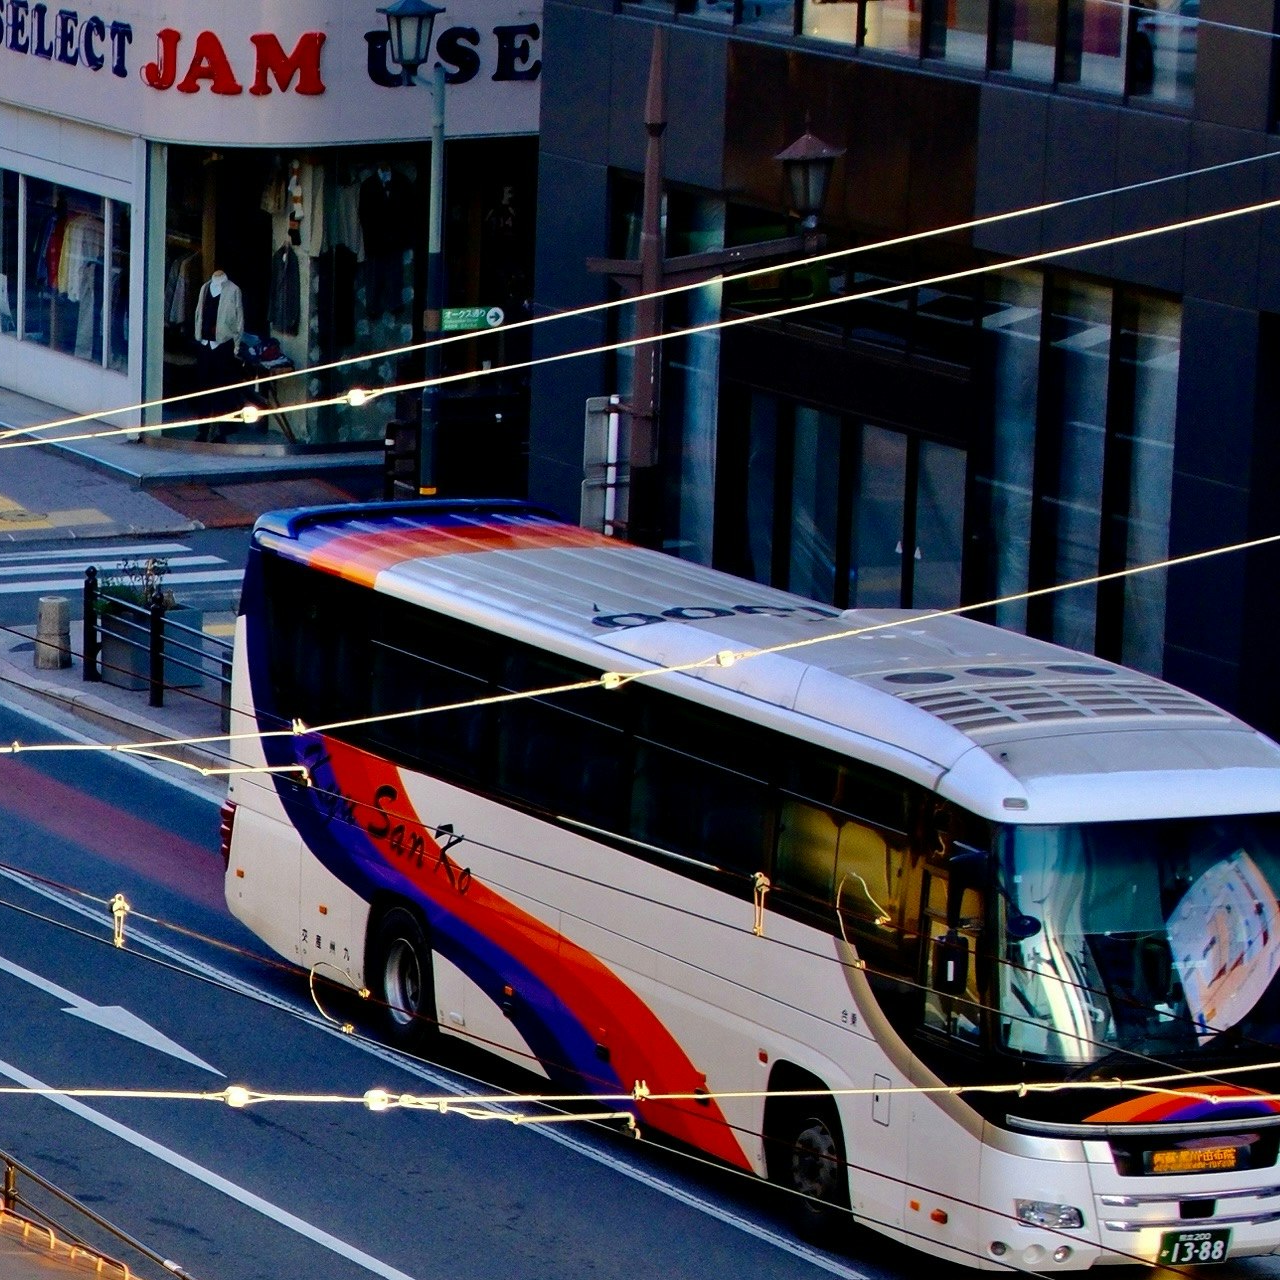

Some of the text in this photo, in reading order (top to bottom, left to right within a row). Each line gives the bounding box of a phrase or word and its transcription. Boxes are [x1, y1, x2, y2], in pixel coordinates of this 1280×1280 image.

[141, 28, 324, 96] JAM
[367, 784, 426, 869] San
[1171, 1240, 1225, 1263] 13-88
